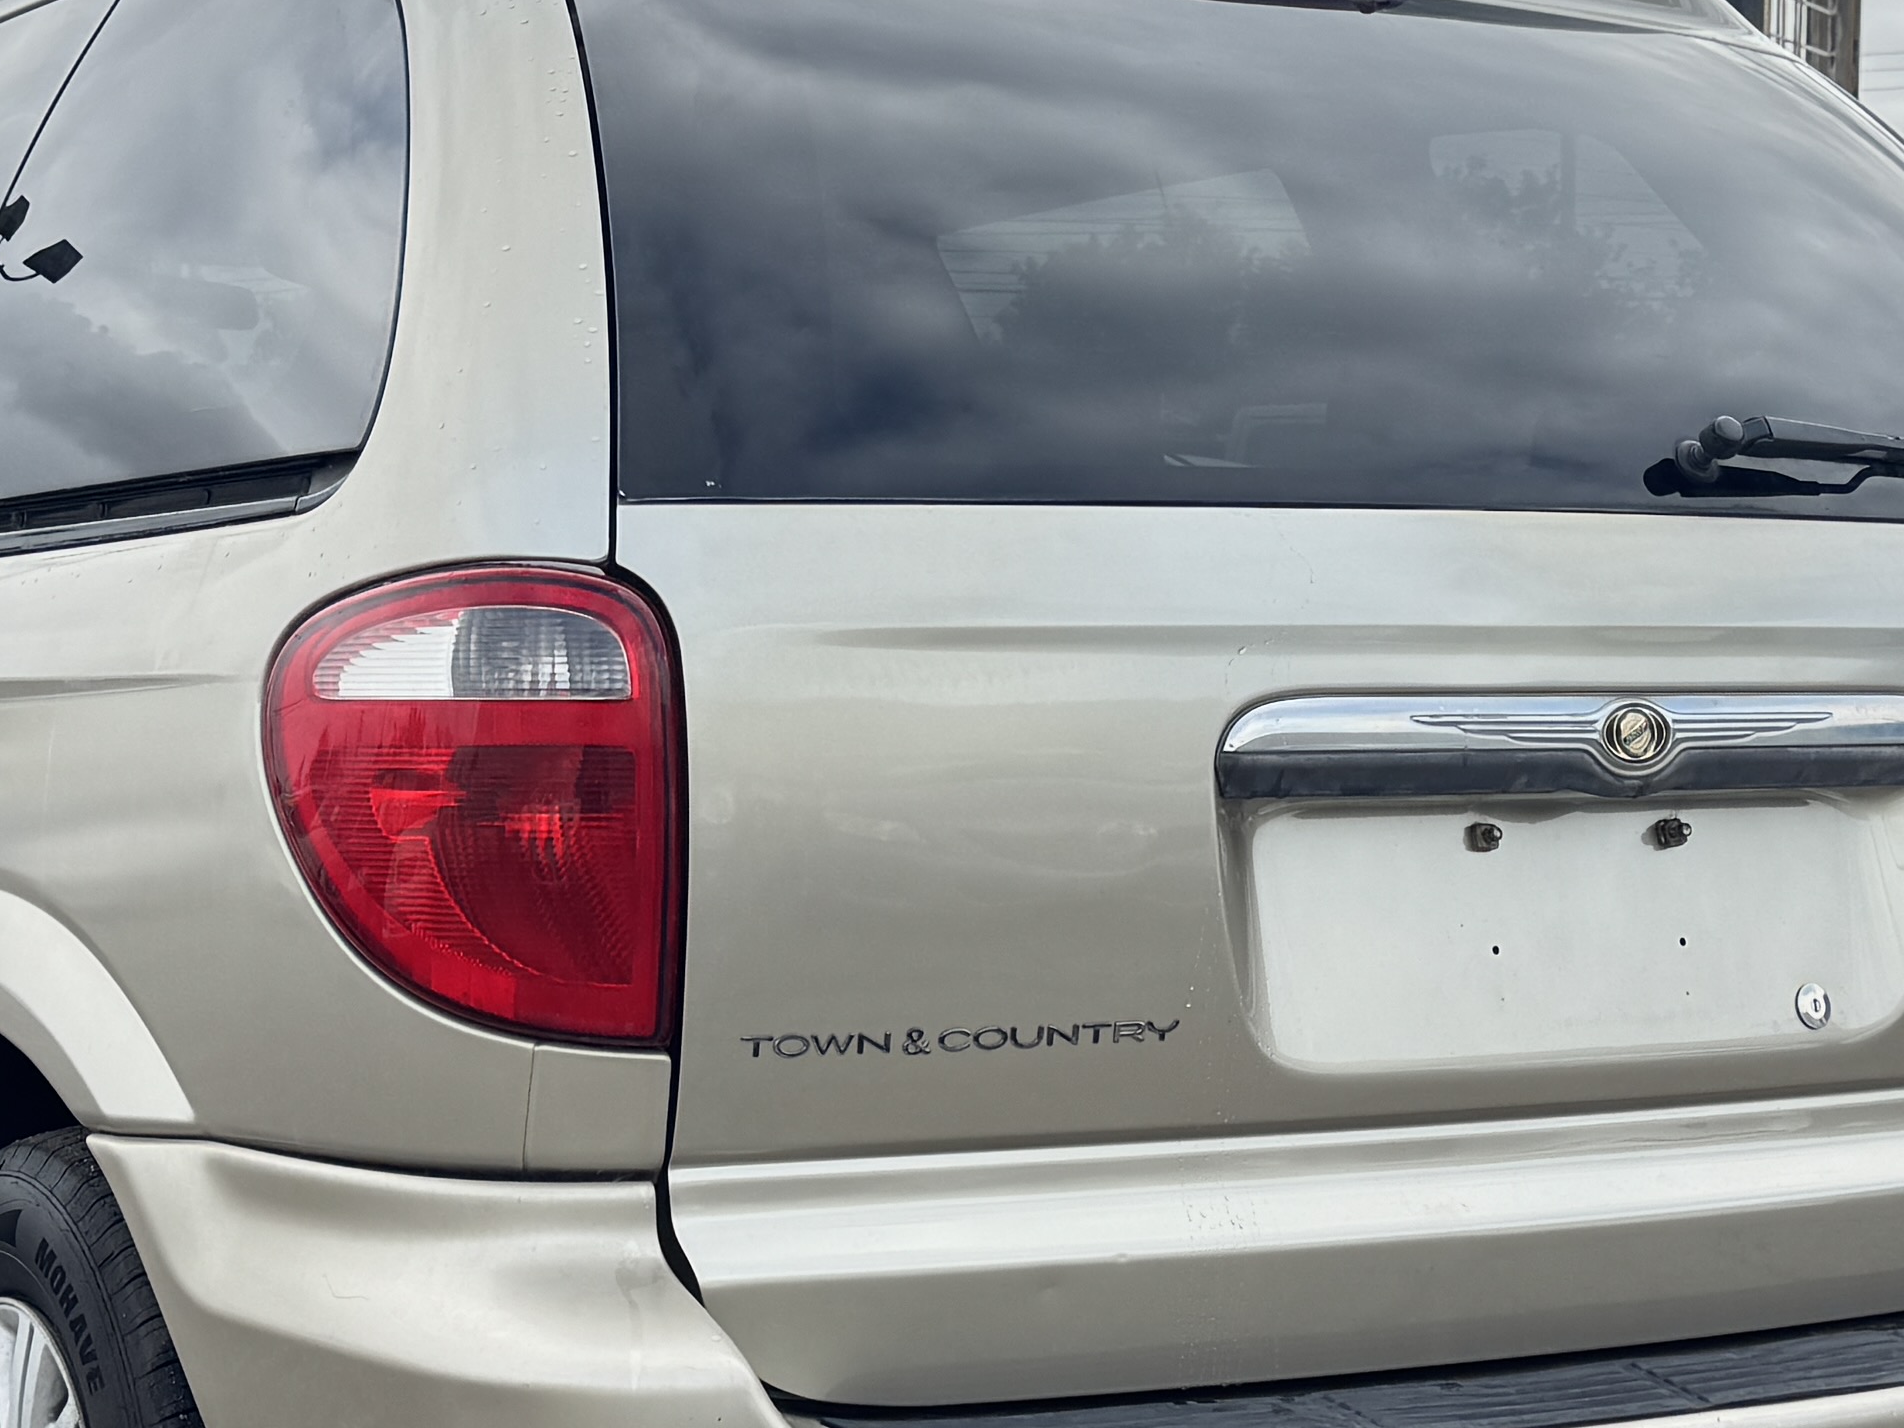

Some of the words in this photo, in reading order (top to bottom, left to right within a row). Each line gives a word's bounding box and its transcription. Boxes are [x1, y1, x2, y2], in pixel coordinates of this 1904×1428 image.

[740, 1031, 892, 1059] TOWN
[901, 1027, 931, 1056] &
[937, 1019, 1180, 1052] COUNTRY
[34, 1237, 105, 1395] MOHAVE
